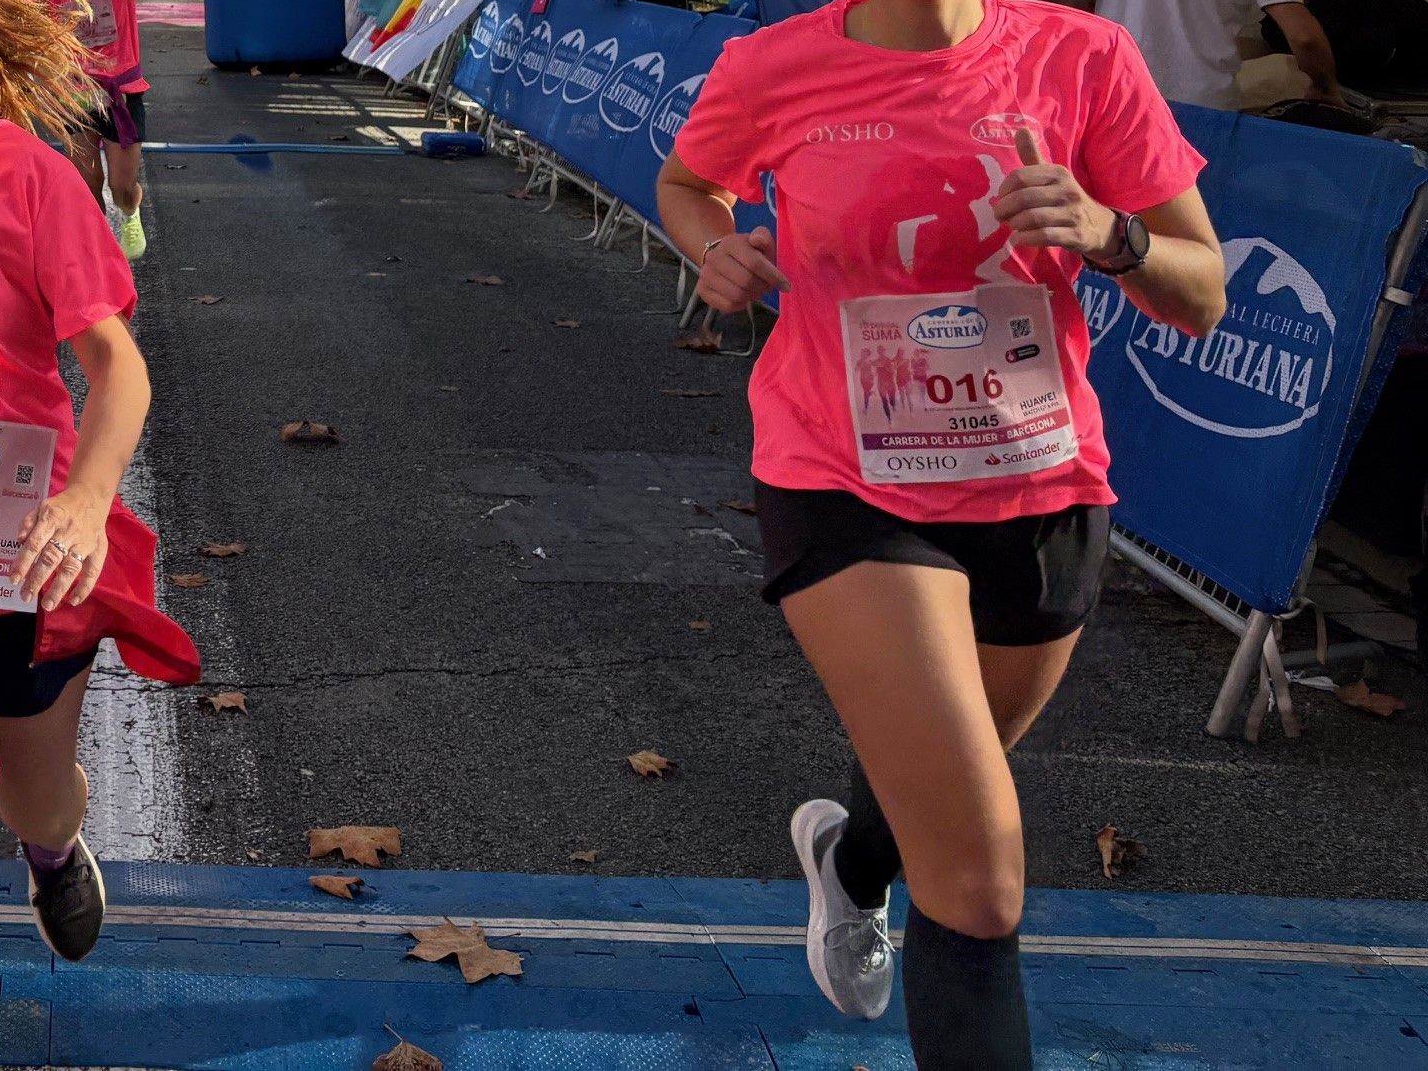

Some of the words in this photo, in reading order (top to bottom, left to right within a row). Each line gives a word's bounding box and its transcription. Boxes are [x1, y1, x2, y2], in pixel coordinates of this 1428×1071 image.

[805, 121, 894, 145] OYSHO
[861, 328, 903, 341] SUMA
[1252, 309, 1321, 348] LECHERA
[925, 368, 1004, 405] 016
[1019, 391, 1058, 411] HUAWEI
[881, 436, 928, 447] CARRERA
[930, 436, 944, 446] DE
[946, 435, 960, 446] LA
[962, 432, 998, 446] MUJER
[1006, 418, 1057, 439] BARCELONA
[948, 414, 1000, 431] 31045
[887, 455, 957, 471] OYSHO
[1002, 441, 1061, 465] Santander
